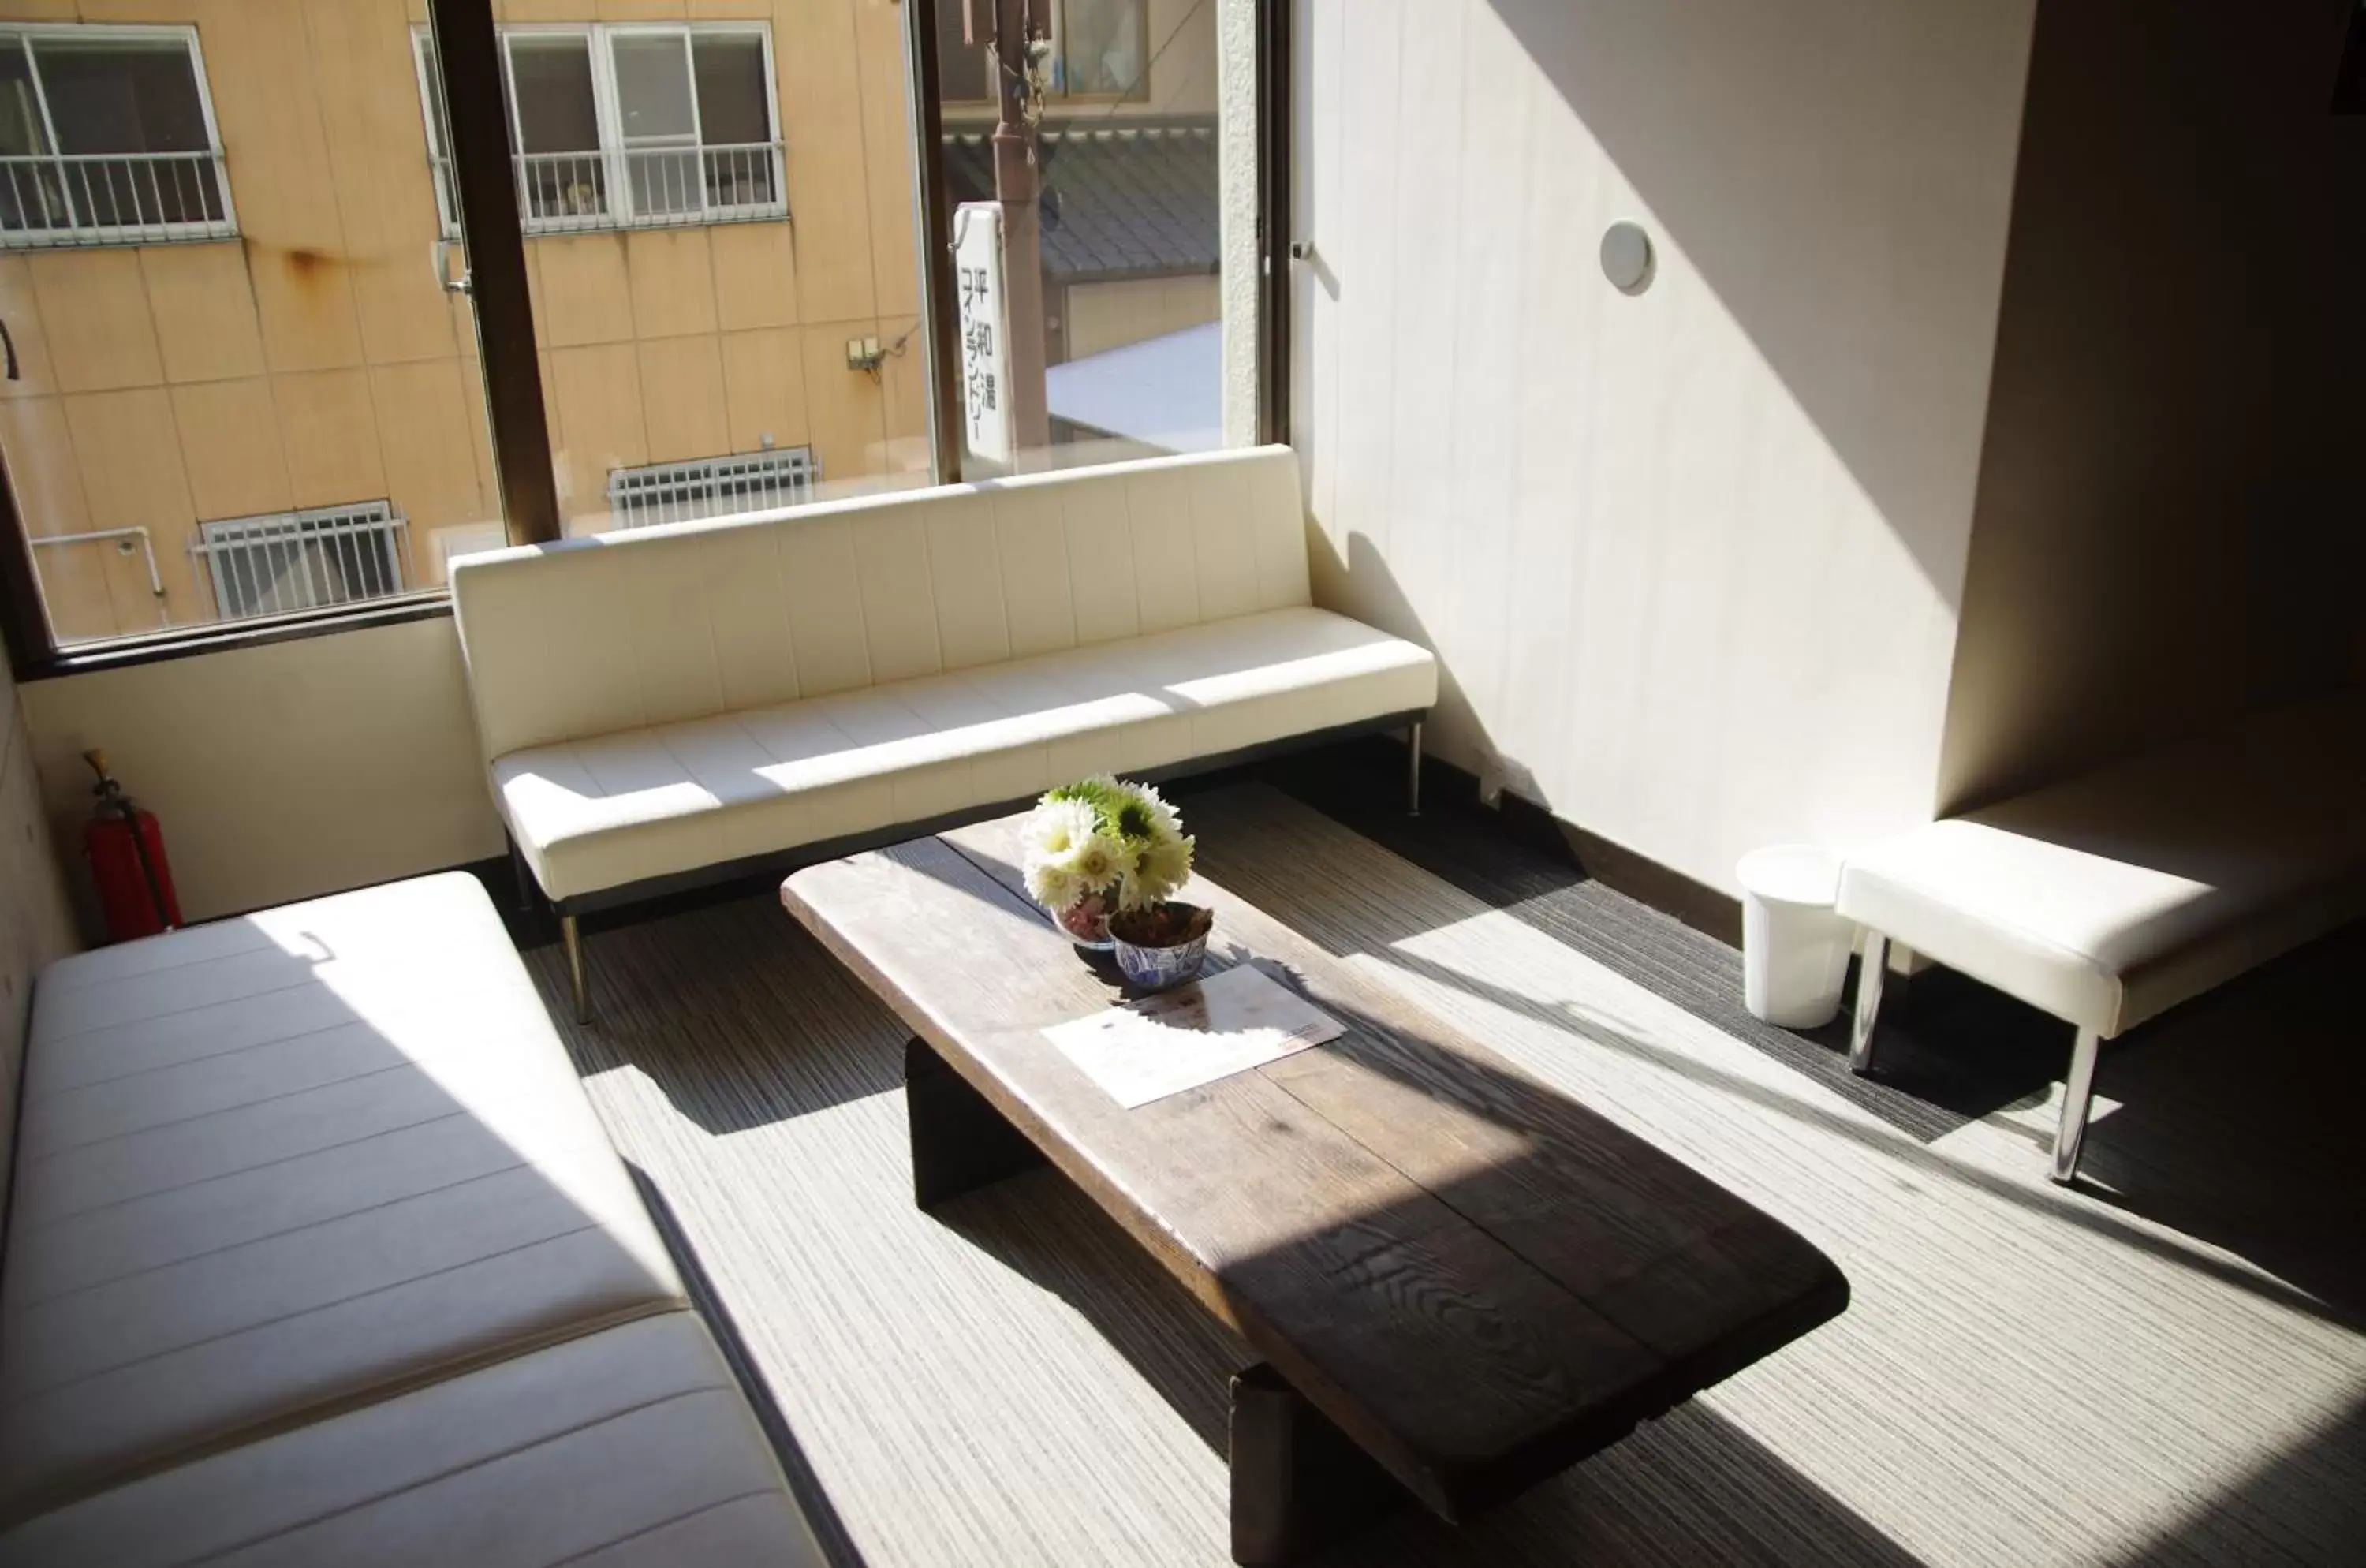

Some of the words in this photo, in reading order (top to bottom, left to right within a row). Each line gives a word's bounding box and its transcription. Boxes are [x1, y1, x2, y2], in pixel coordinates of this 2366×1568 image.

[961, 268, 981, 440] コインランドリー
[974, 268, 995, 409] 平和湯
